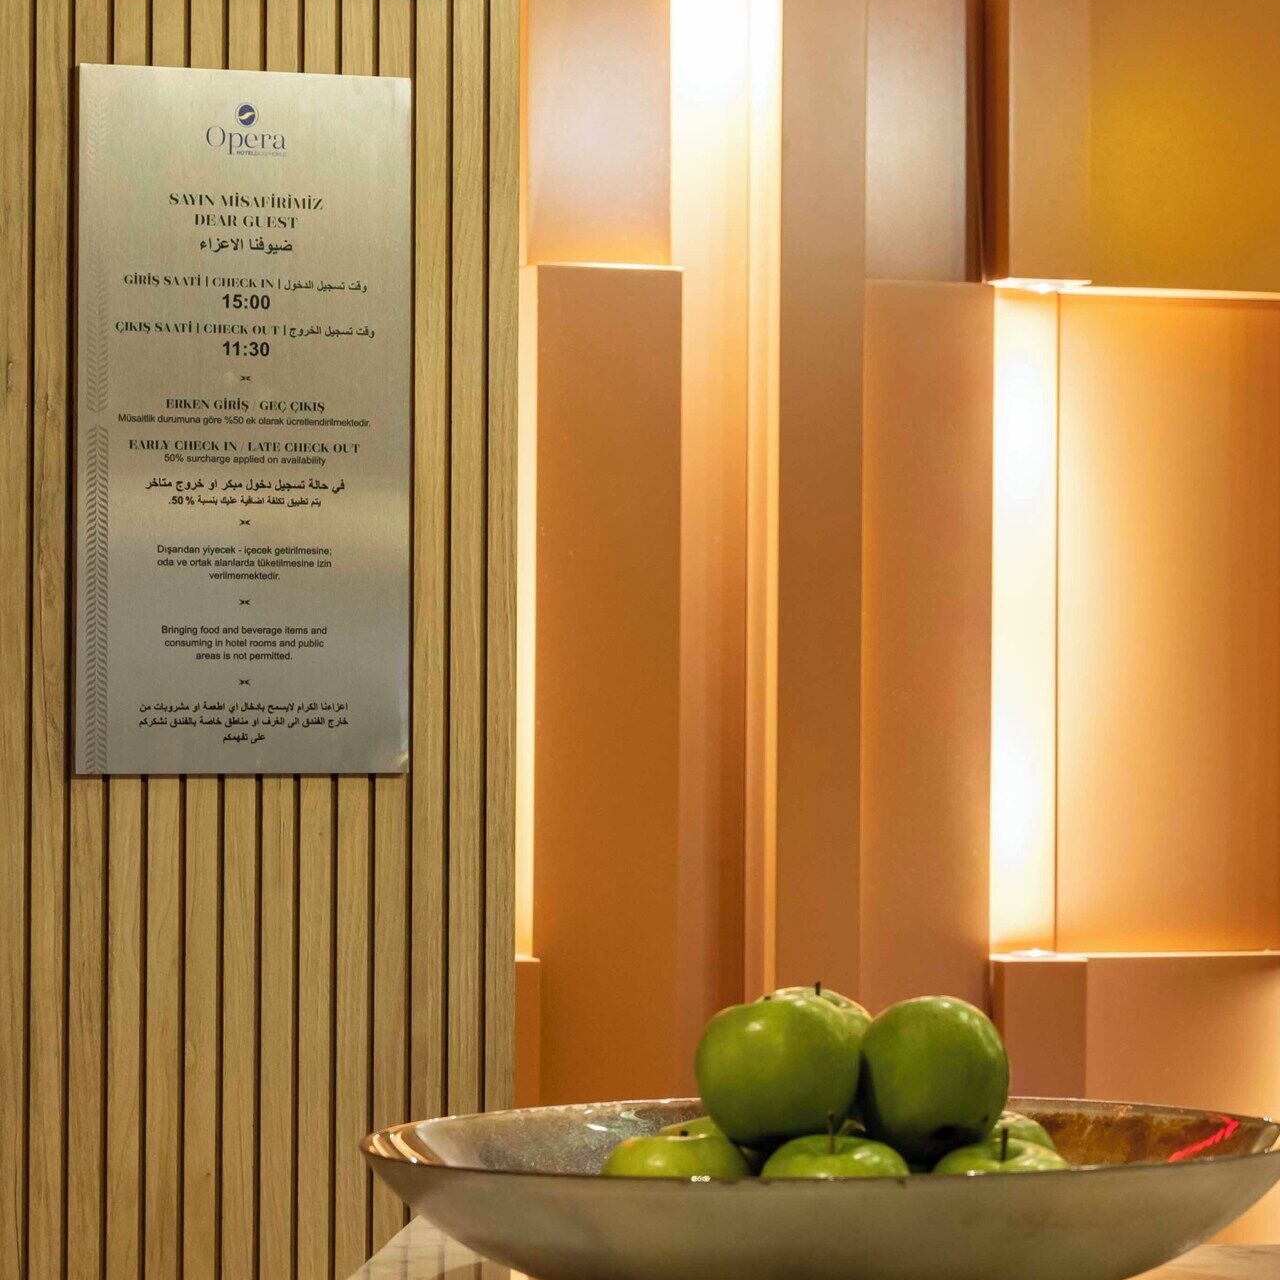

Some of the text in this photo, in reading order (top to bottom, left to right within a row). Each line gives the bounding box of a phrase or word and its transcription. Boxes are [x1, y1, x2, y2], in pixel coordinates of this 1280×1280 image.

[205, 126, 286, 156] Opera
[168, 192, 323, 210] SAYIN MİSAFİRİMİZ
[194, 213, 298, 229] DEAR GUEST
[123, 272, 160, 287] GİRİŞ
[163, 273, 200, 287] SAATİ
[212, 276, 257, 288] CHECK
[260, 278, 273, 288] IN
[222, 293, 270, 310] 15:00
[115, 320, 151, 334] ÇIKIŞ
[154, 320, 192, 333] SAATİ
[203, 323, 248, 334] CHECK
[252, 324, 279, 335] OUT
[222, 340, 270, 357] 11:30
[166, 398, 210, 409] ERKEN
[213, 397, 249, 413] GİRİŞ
[259, 400, 286, 413] GEÇ
[289, 400, 324, 414] ÇIKIŞ
[224, 415, 244, 425] %50
[245, 416, 256, 425] ek
[128, 438, 170, 450] EARLY
[174, 439, 219, 451] CHECK
[224, 440, 236, 451] IN
[247, 441, 280, 452] LATE
[284, 441, 329, 453] CHECK
[332, 442, 360, 453] OUT
[164, 452, 326, 467] 50% surcharge applied on availability
[156, 544, 200, 555] Dışarıdan
[202, 544, 236, 556] yiyecek
[244, 545, 272, 556] içecek
[274, 545, 331, 556] getirilmesine;
[156, 557, 174, 566] oda
[189, 557, 212, 567] ortak
[214, 557, 254, 567] alanlarda
[256, 557, 314, 567] tüketilmesine
[316, 558, 331, 568] izin
[208, 570, 280, 580] verilmemektedir.
[161, 624, 327, 636] Bringing food and beverage items and
[164, 638, 324, 649] consuming in hotel rooms and public
[195, 650, 292, 662] areas is not permitted.
